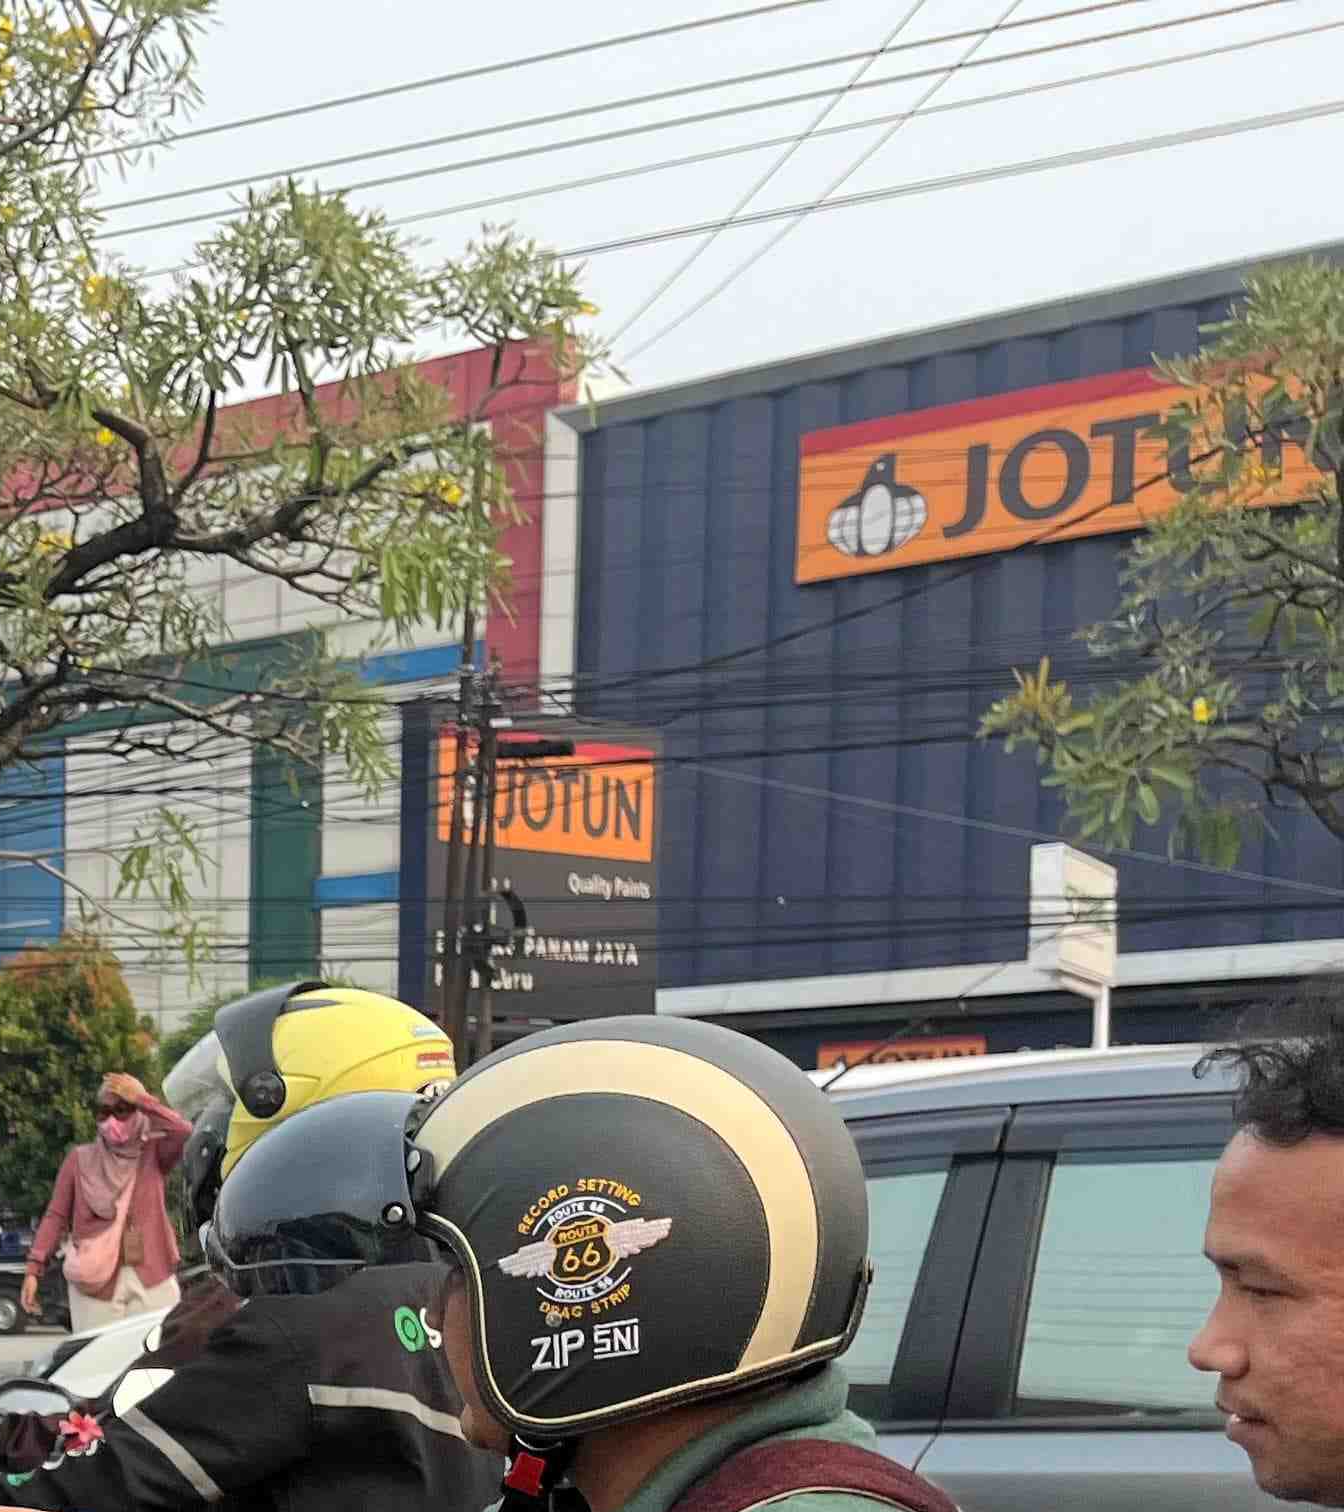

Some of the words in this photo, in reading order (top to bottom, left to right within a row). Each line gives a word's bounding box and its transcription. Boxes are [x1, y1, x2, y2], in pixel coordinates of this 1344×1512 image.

[498, 768, 642, 842] JOTUN
[568, 872, 613, 900] Quality
[614, 876, 651, 900] Paints
[524, 936, 589, 963] PANAM
[594, 942, 639, 967] JAYA
[518, 1184, 569, 1234] RECORD
[577, 1178, 641, 1207] SETTING
[548, 1201, 585, 1227] ROUTE
[559, 1223, 599, 1242] ROUTE
[563, 1242, 601, 1272] 66
[539, 1301, 583, 1320] DRAG
[591, 1284, 632, 1314] STRIP
[554, 1283, 595, 1299] ROUTE
[531, 1329, 585, 1371] ZIP
[594, 1320, 640, 1357] SNI
